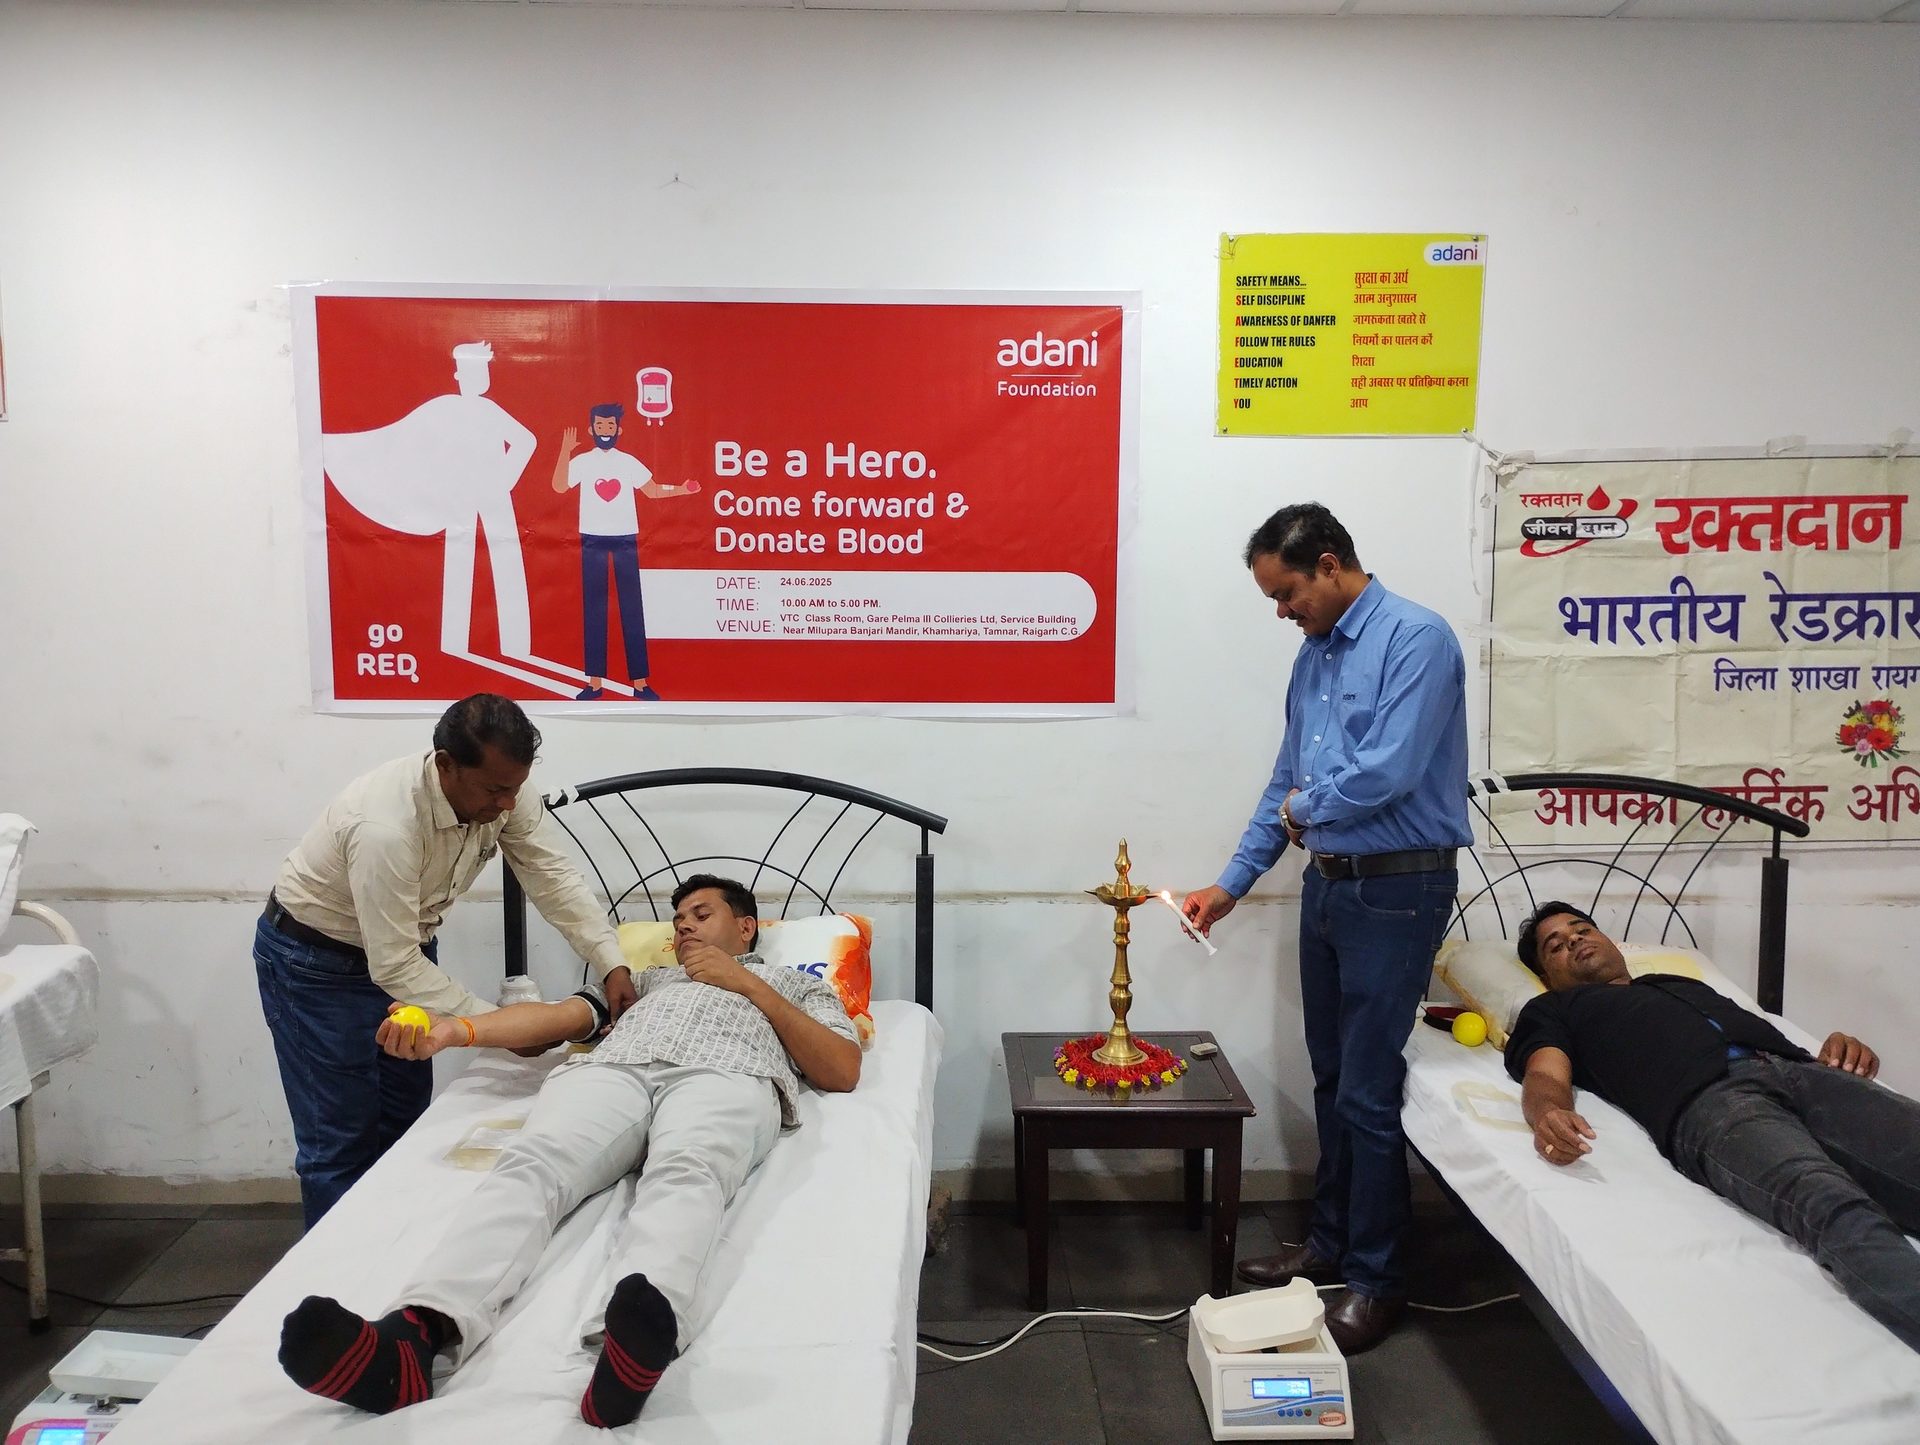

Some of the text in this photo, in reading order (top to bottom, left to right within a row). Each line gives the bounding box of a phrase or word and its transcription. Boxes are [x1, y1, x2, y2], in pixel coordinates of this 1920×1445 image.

[1432, 245, 1478, 261] adani
[1236, 275, 1267, 286] SAFETY
[1355, 269, 1409, 288] सुरक्षा का अर्थ
[1236, 294, 1305, 305] SELF DISCIPLINE
[1354, 293, 1417, 307] आत्म अनुशासन
[1235, 315, 1336, 326] AWARENESS OF DANFER
[1419, 312, 1427, 324] से
[1235, 336, 1316, 347] FOLLOW THE RULES
[1352, 333, 1433, 345] नियमों का पालन करें
[996, 330, 1098, 367] adani
[1234, 357, 1283, 368] EDUCATION
[1352, 354, 1375, 366] शिक्षा
[1234, 377, 1298, 388] TIMELY ACTION
[1351, 374, 1367, 389] सही
[1396, 377, 1406, 387] पर
[1408, 374, 1445, 388] प्रतिक्रिया
[1447, 377, 1469, 387] करना
[997, 381, 1097, 397] Foundation
[1233, 399, 1251, 409] YOU
[1350, 398, 1368, 408] आप
[714, 441, 937, 479] Be a Hero.
[713, 489, 969, 519] Come forward &
[1520, 493, 1583, 508] रक्तदान
[1524, 519, 1574, 536] जीवन
[1654, 494, 1909, 555] रक्तदान
[715, 527, 923, 554] Donate Blood
[716, 577, 832, 590] DATE: 24.06.2025
[716, 598, 881, 611] TIME: 10.00 AM to 5.00 PM.
[1558, 575, 1746, 647] भारतीय
[716, 619, 776, 633] VENUE:
[780, 614, 800, 622] VTC
[805, 614, 831, 623] Class
[834, 614, 864, 624] Room,
[866, 614, 889, 623] Gare
[891, 614, 920, 623] Pelma
[933, 615, 977, 624] Collieries
[980, 615, 998, 625] Ltd,
[1000, 615, 1035, 624] Service
[1037, 615, 1076, 625] Building
[368, 623, 403, 648] go
[783, 626, 1081, 637] Near Milupara Banjari Mandir, Khamhariya, Tamnar, Raigarh C.G.
[357, 652, 419, 682] RED
[1713, 657, 1779, 692] जिला
[1788, 666, 1861, 693] शाखा
[1534, 787, 1678, 827] आपका
